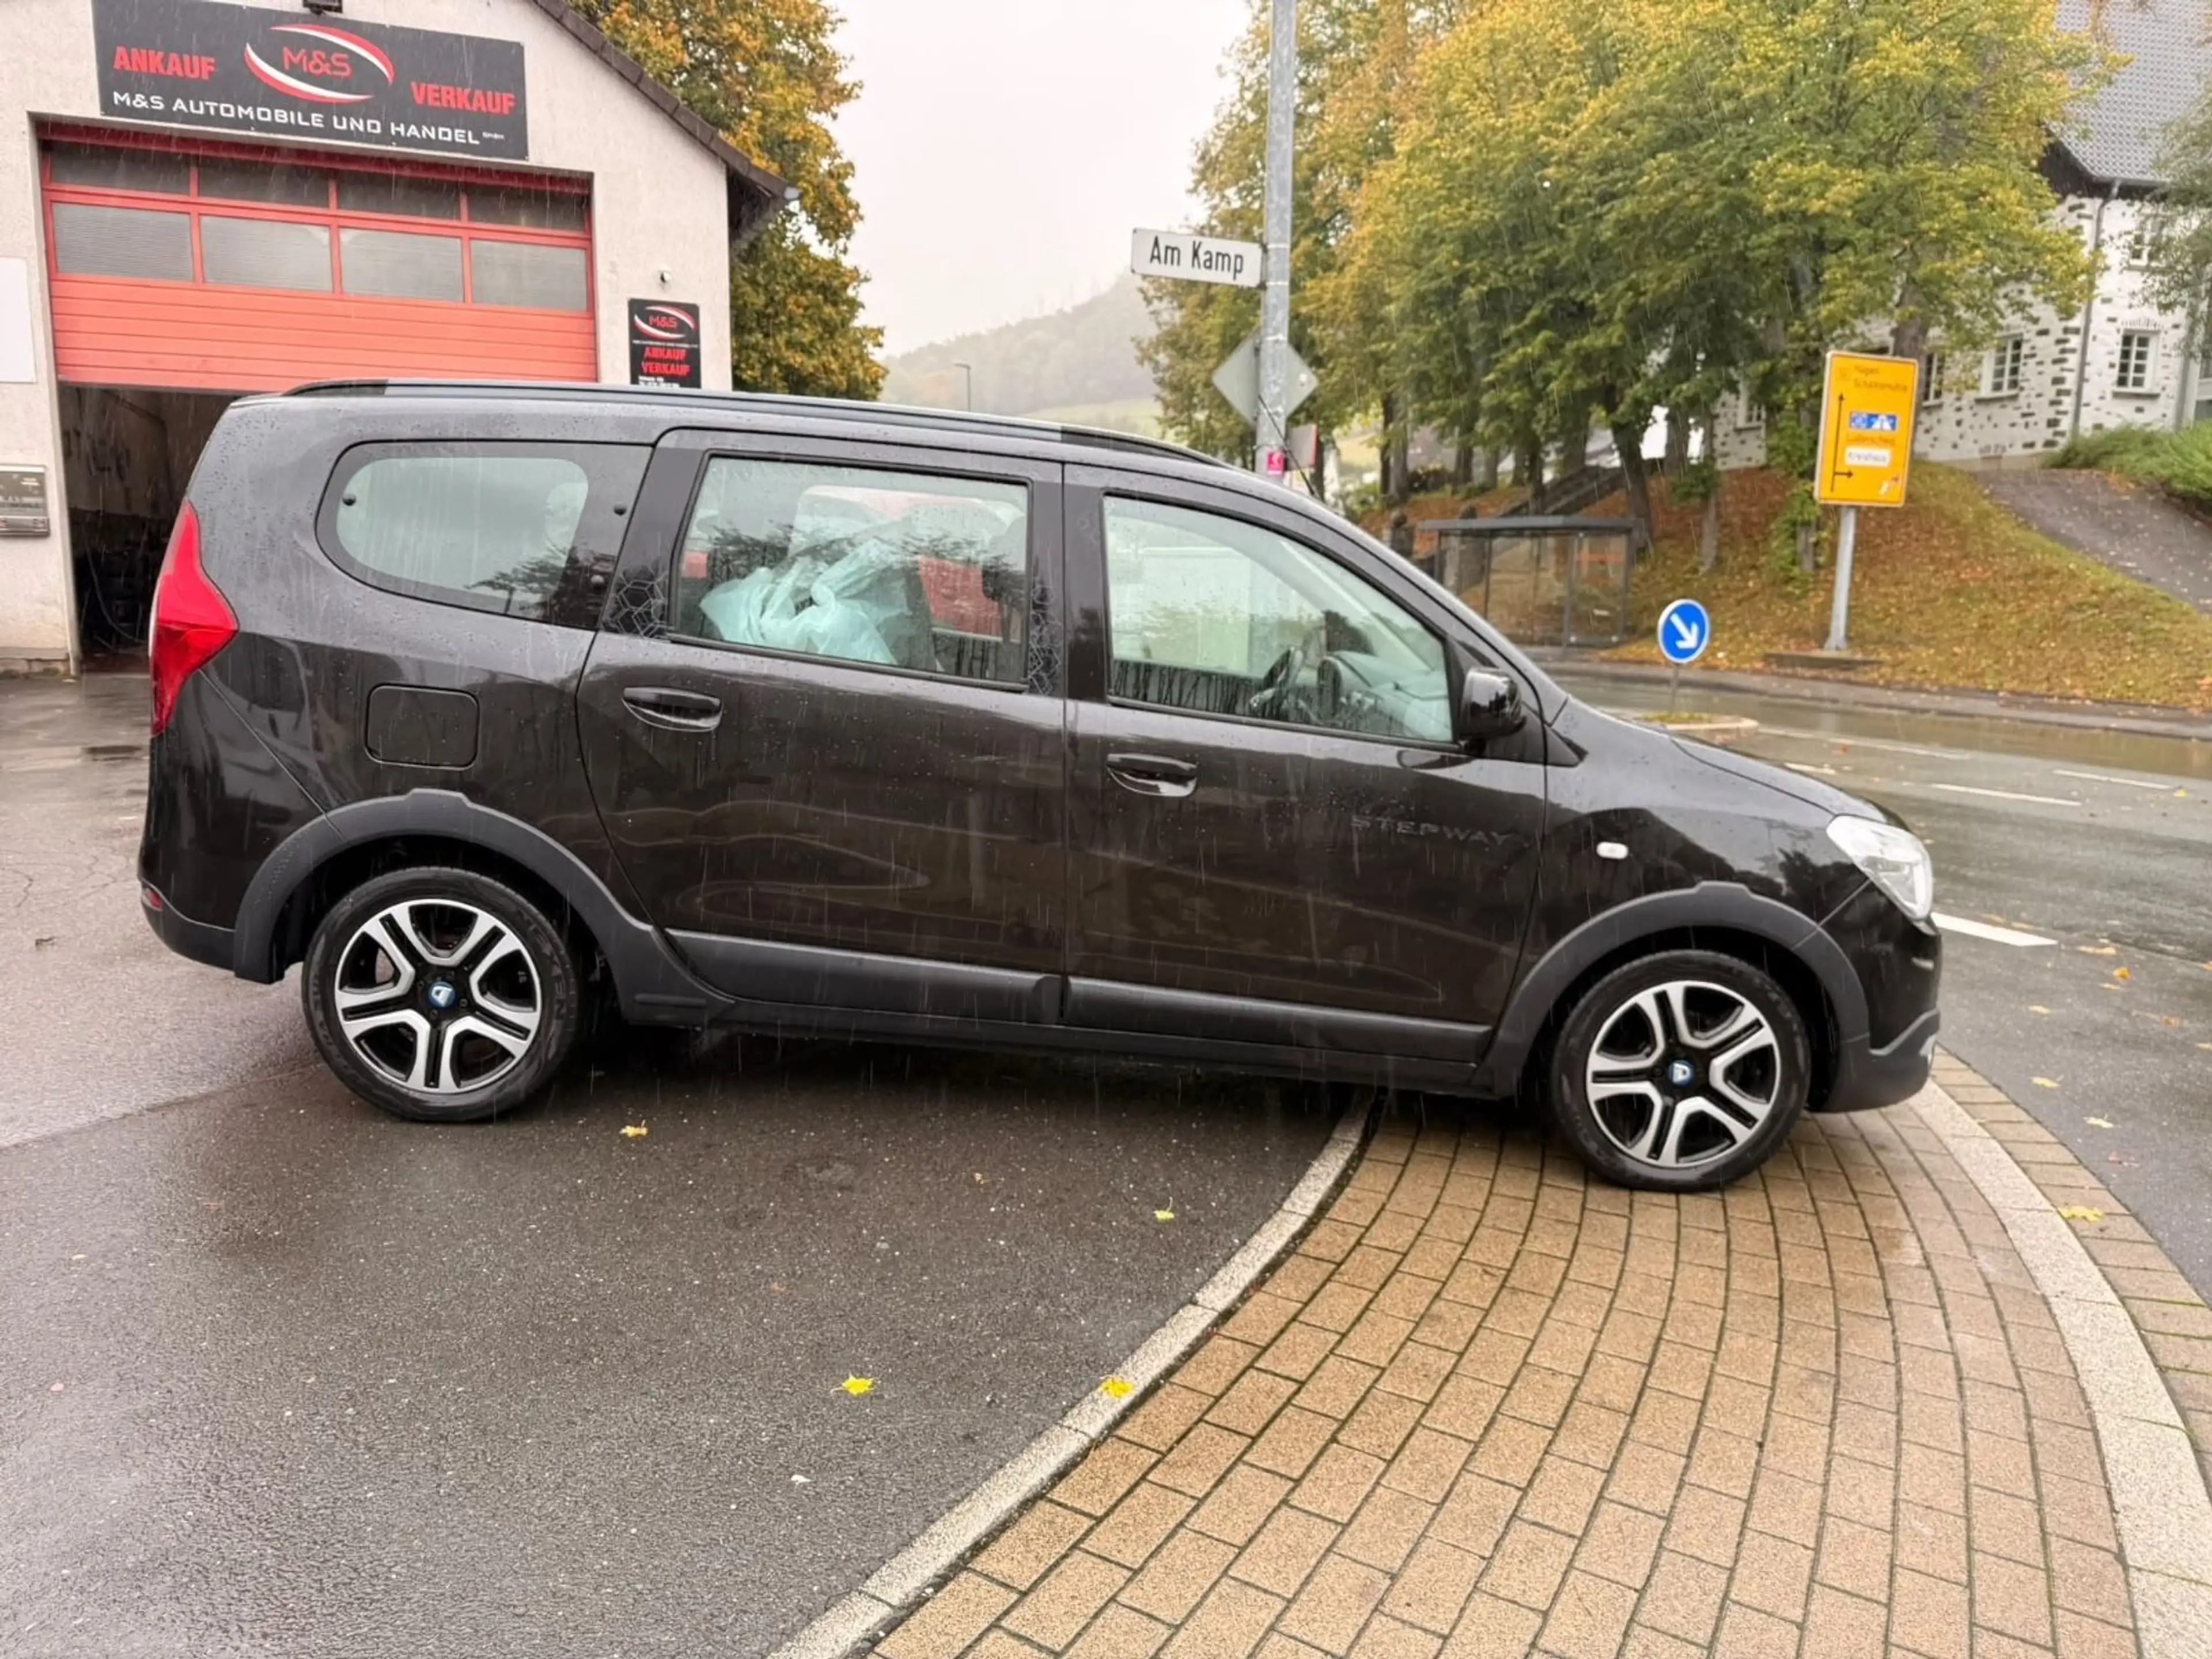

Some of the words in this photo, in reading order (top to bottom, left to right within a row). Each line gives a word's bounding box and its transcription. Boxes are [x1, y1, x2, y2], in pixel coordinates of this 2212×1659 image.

[113, 46, 215, 80] ANKAUF
[282, 46, 352, 77] M&S
[411, 81, 516, 115] VERKAUF
[113, 90, 165, 110] M&S
[172, 98, 324, 128] AUTOMOBILE
[332, 115, 381, 134] UND
[390, 122, 480, 145] HANDEL
[1150, 235, 1181, 267] Am
[1191, 240, 1244, 281] Kamp
[641, 361, 691, 376] VERKAUF
[1351, 816, 1512, 844] STEPWAY
